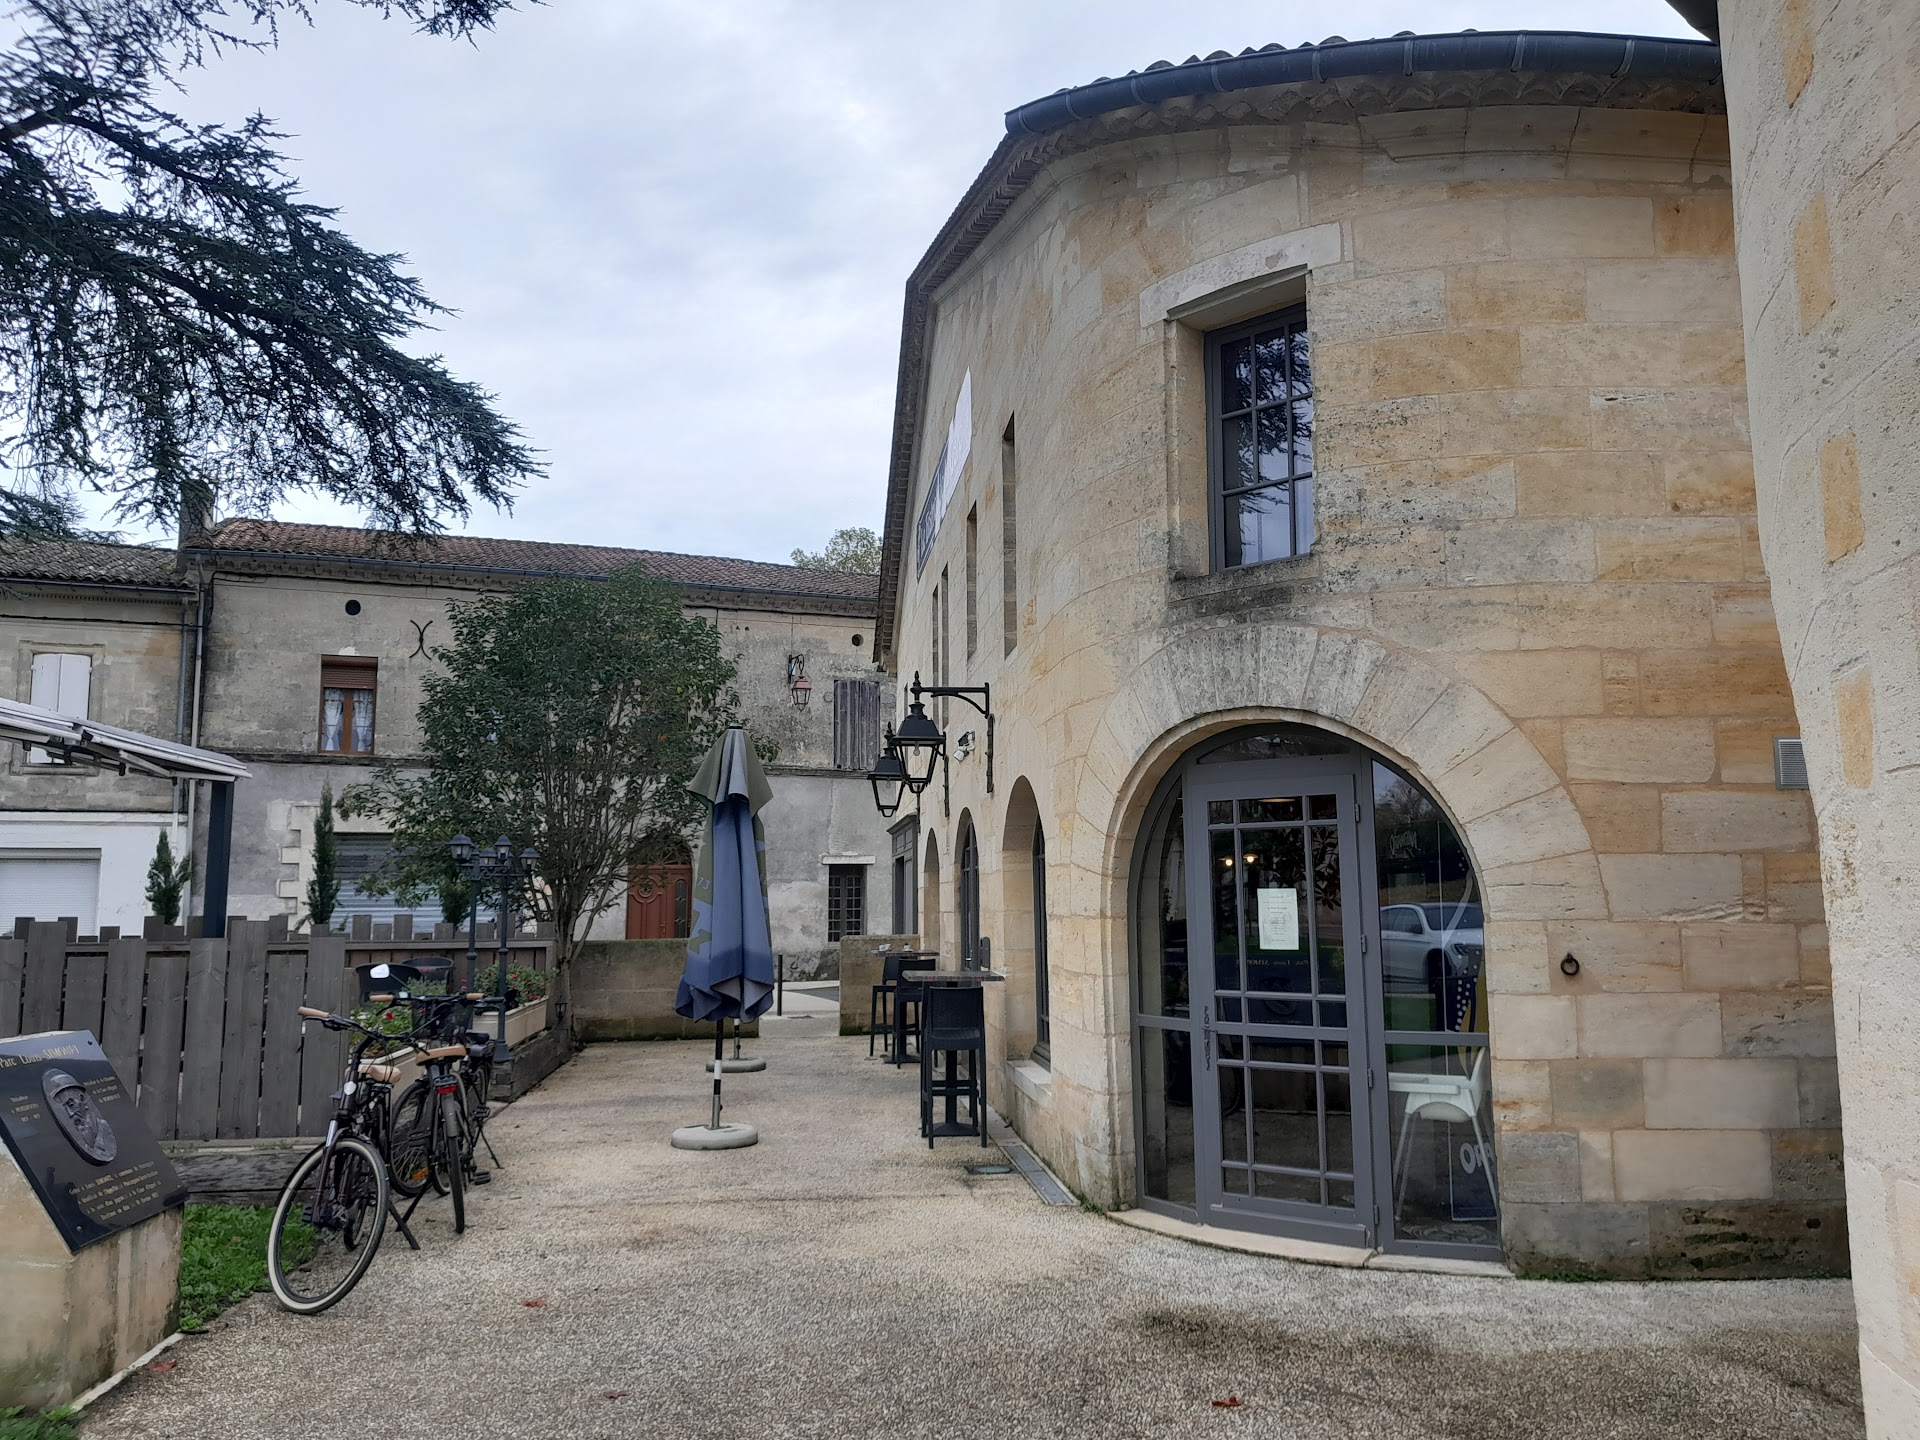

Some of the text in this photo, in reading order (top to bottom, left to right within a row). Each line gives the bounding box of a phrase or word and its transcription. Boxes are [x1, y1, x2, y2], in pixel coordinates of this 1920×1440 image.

[0, 1044, 80, 1069] Parc Louis SIMONET
